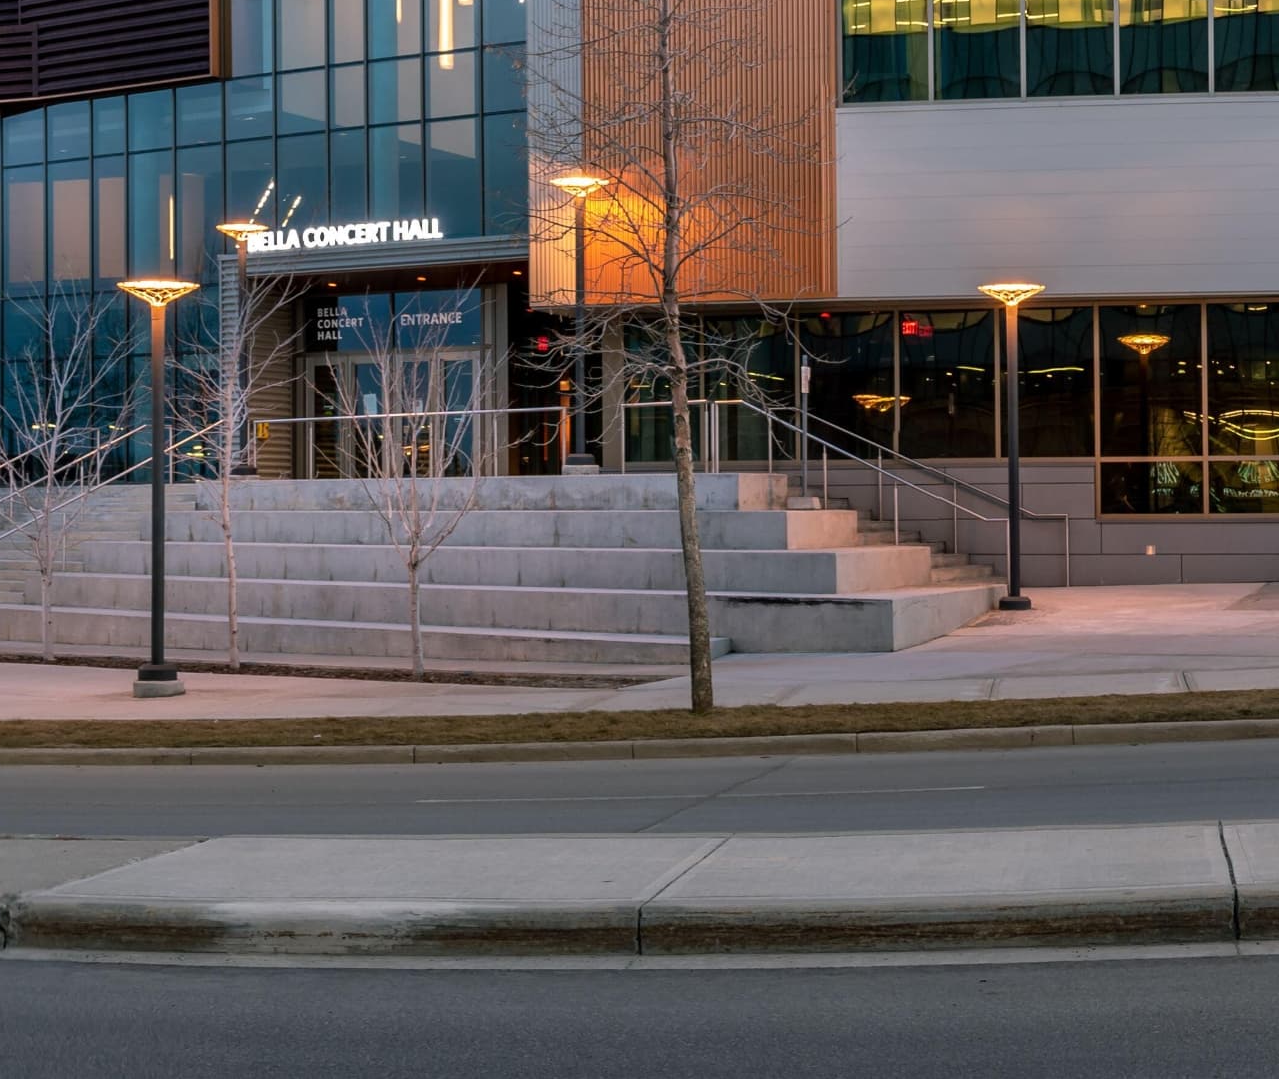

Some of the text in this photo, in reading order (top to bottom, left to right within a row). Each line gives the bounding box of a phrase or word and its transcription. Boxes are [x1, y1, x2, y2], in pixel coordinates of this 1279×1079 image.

[247, 218, 444, 252] BELLA CONCERT HALL
[317, 307, 348, 318] BELLA
[400, 311, 463, 326] ENTRANCE
[317, 317, 364, 329] CONCERT
[317, 330, 343, 341] HALL
